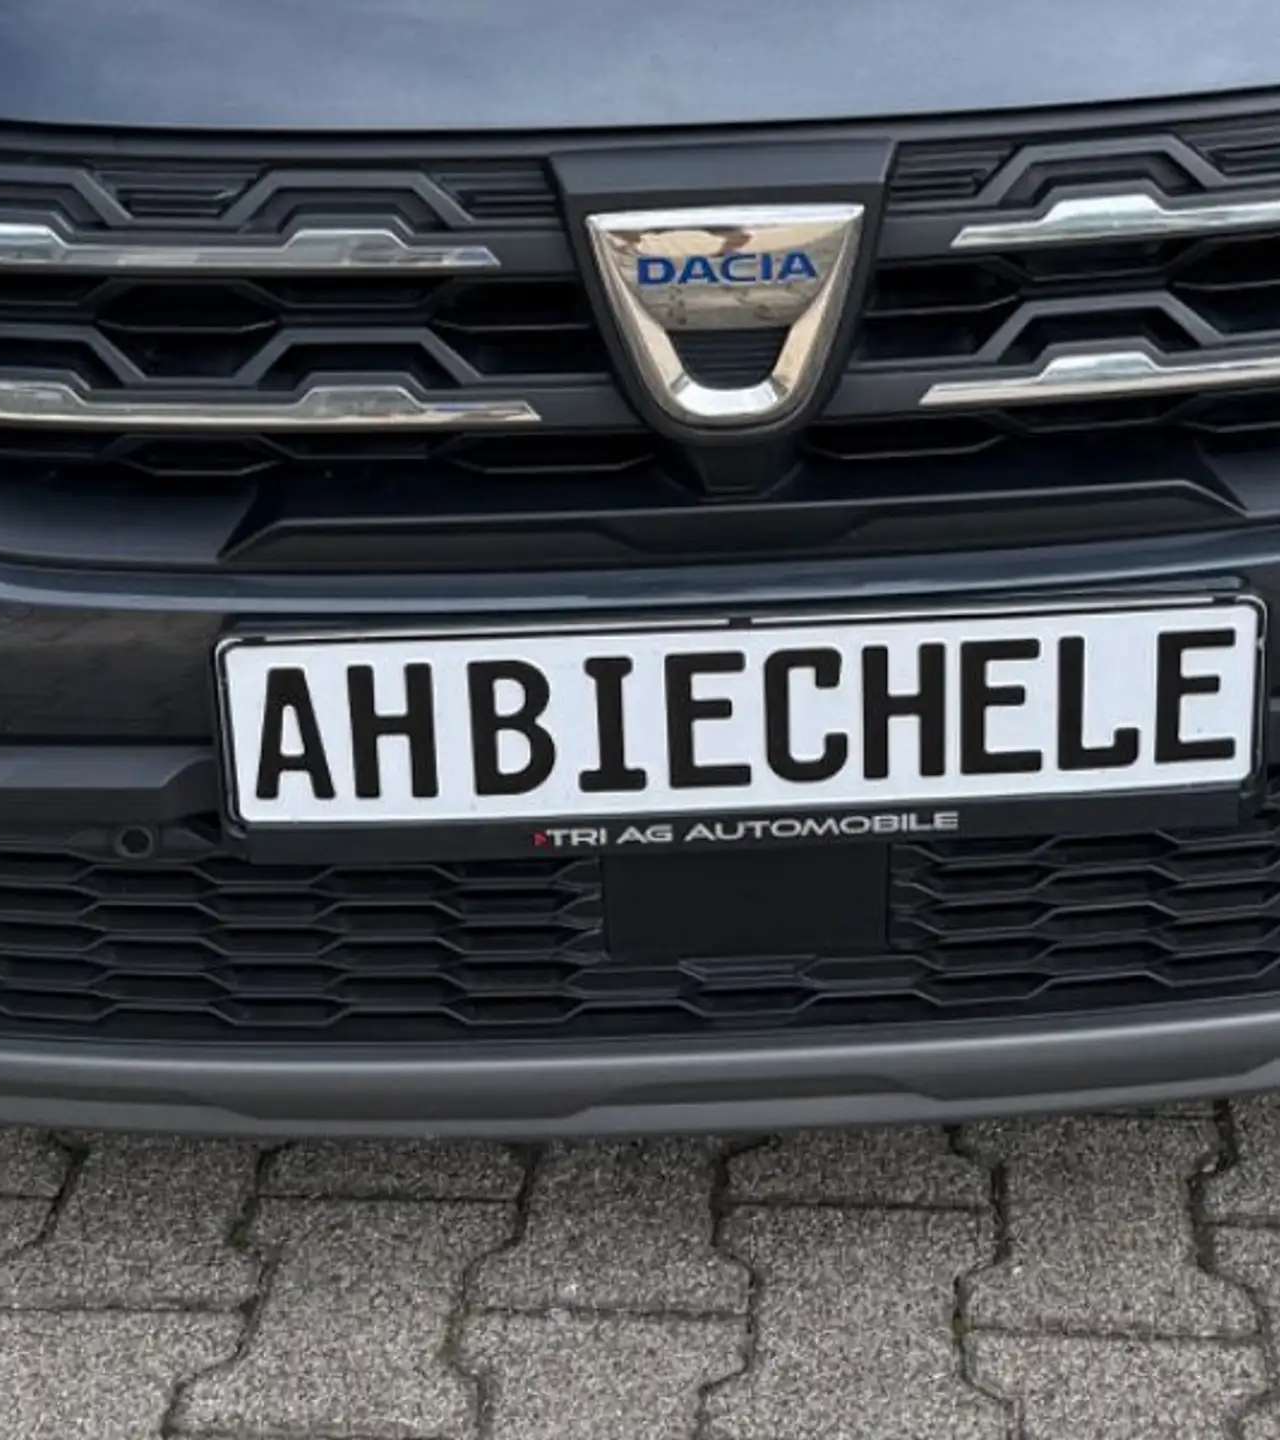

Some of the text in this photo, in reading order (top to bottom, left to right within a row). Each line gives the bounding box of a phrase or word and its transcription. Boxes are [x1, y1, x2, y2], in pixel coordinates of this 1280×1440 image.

[637, 250, 818, 285] DACIA
[254, 628, 1237, 801] AHBIECHELE
[547, 811, 959, 847] TRI AG AUTOMOBILE
